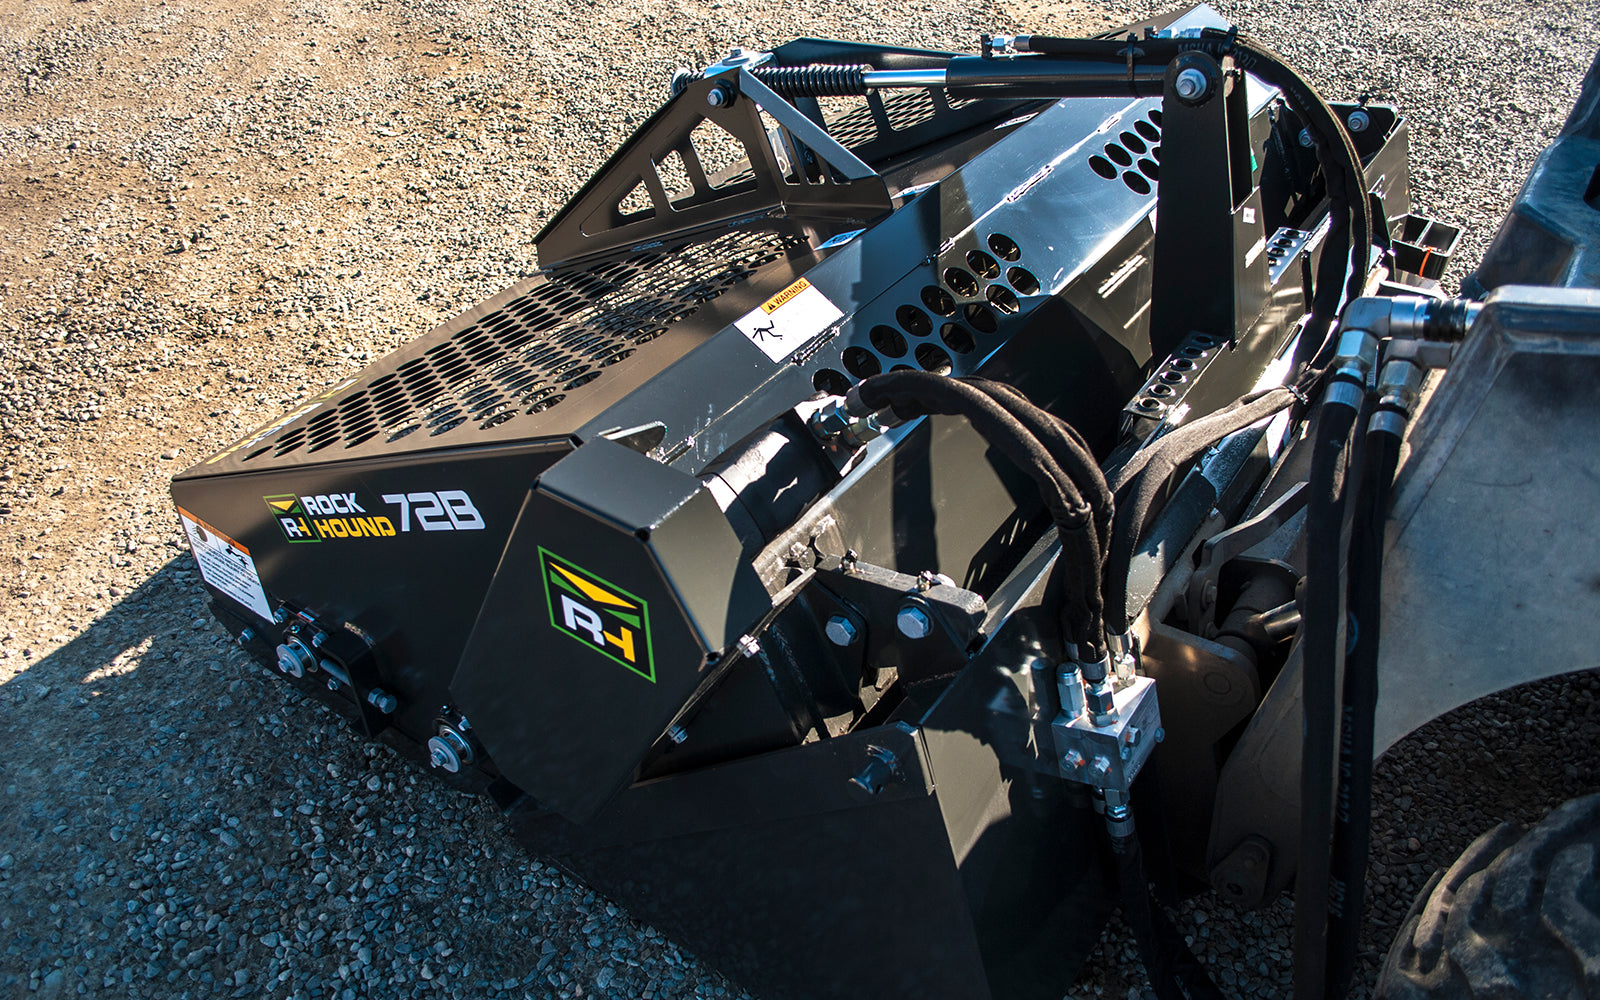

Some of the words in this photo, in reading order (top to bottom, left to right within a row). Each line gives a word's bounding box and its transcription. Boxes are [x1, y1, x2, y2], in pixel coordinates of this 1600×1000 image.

[774, 281, 807, 305] WARNING
[300, 492, 366, 515] ROCK
[382, 490, 486, 532] 72B
[315, 516, 396, 538] HOUND
